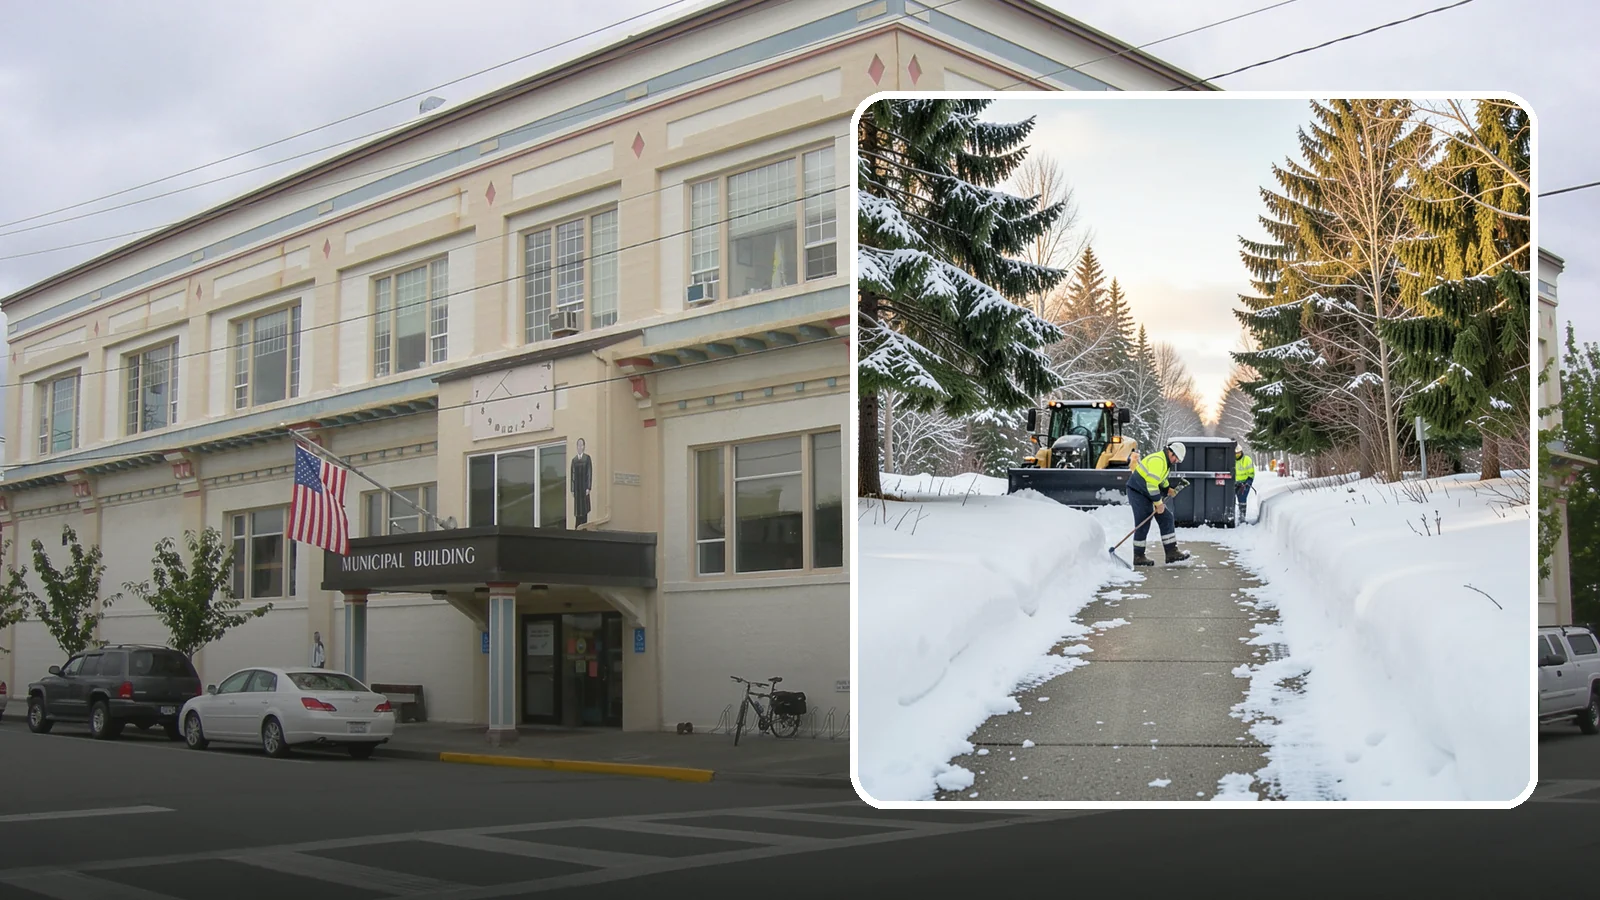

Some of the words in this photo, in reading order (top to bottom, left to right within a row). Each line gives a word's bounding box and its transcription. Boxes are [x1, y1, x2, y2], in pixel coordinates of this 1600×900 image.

[480, 406, 485, 415] 8
[487, 417, 492, 426] 9
[494, 423, 501, 432] 10
[507, 425, 514, 433] 12
[521, 420, 526, 428] 2
[536, 402, 540, 410] 4
[342, 552, 405, 572] MUNICIPAL
[414, 546, 475, 567] BUILDING
